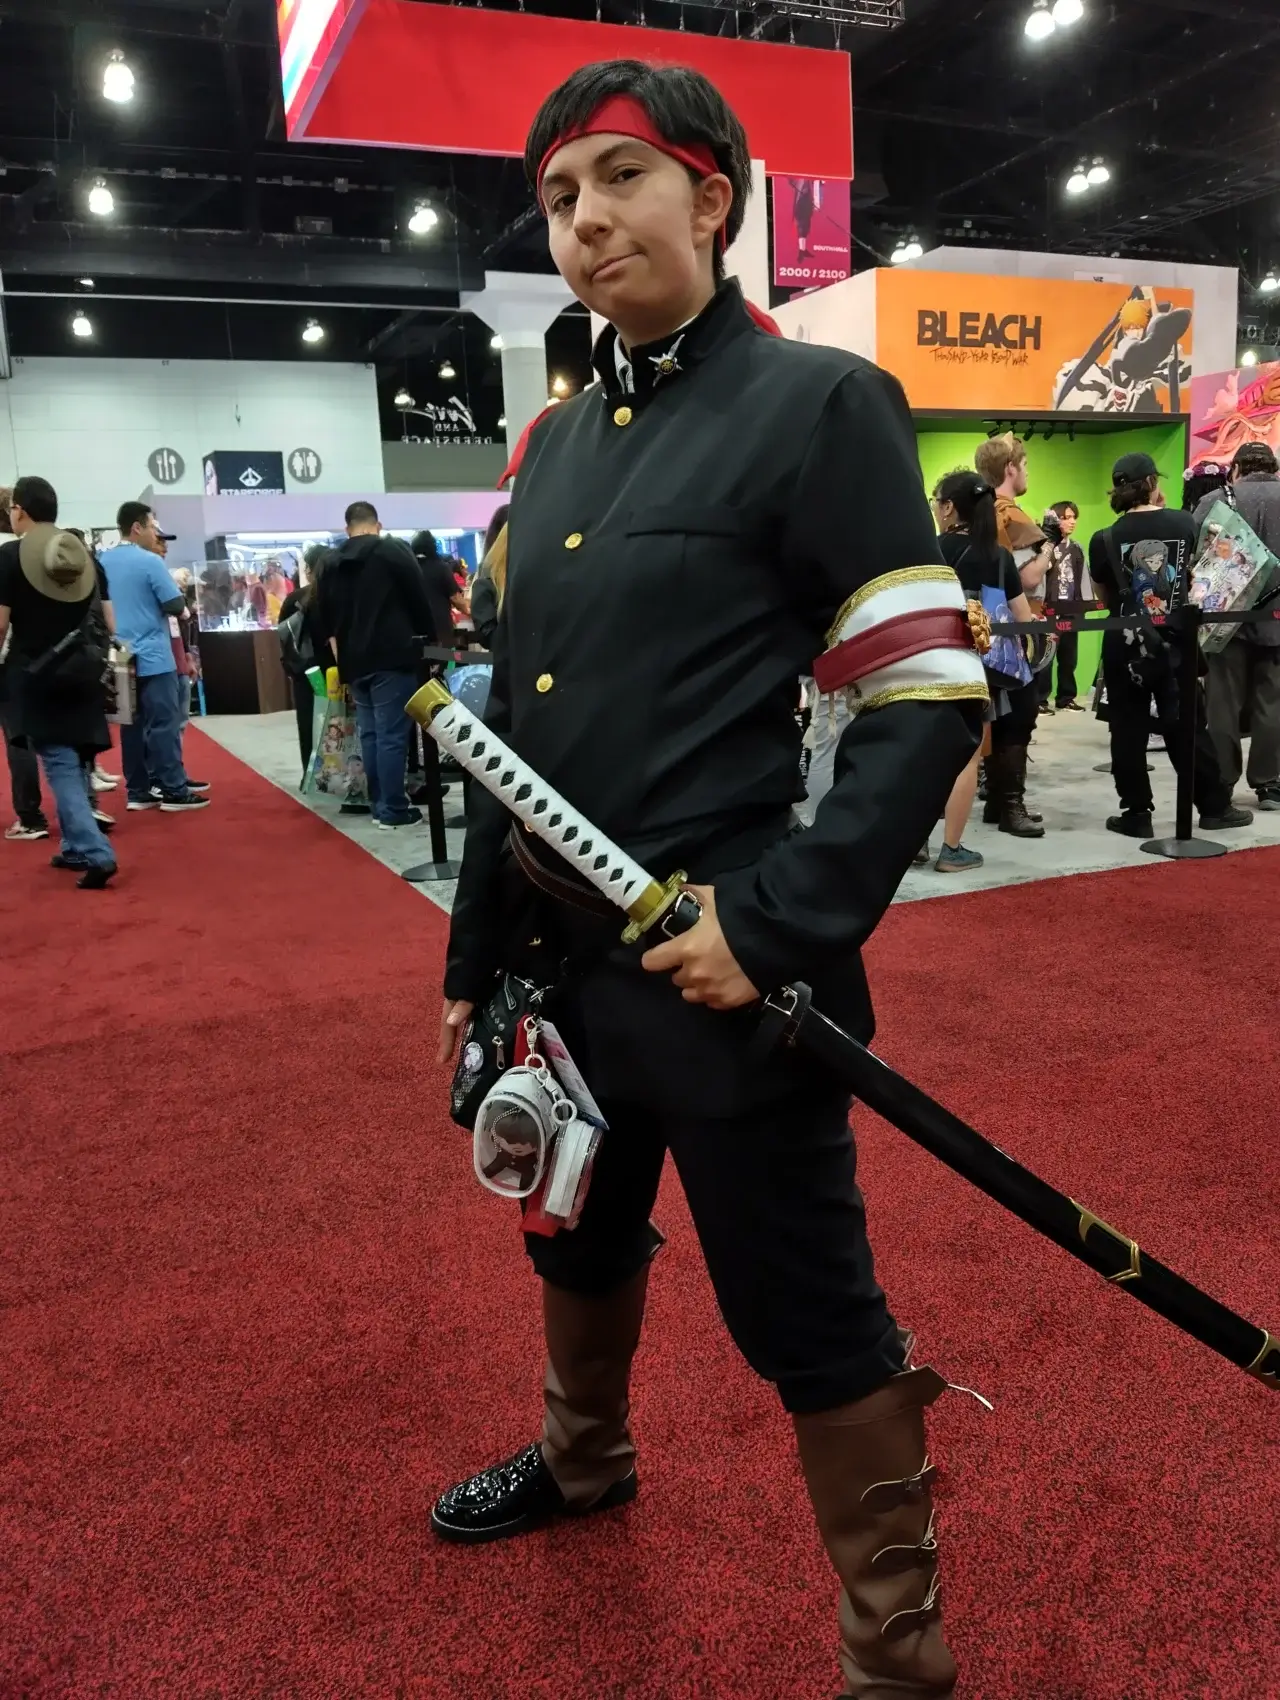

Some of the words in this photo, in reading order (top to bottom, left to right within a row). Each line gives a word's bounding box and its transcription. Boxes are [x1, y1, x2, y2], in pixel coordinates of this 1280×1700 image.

[779, 266, 811, 277] 2000
[818, 269, 847, 279] 2100
[917, 310, 1042, 350] BLEACH
[1056, 621, 1072, 631] VIZ
